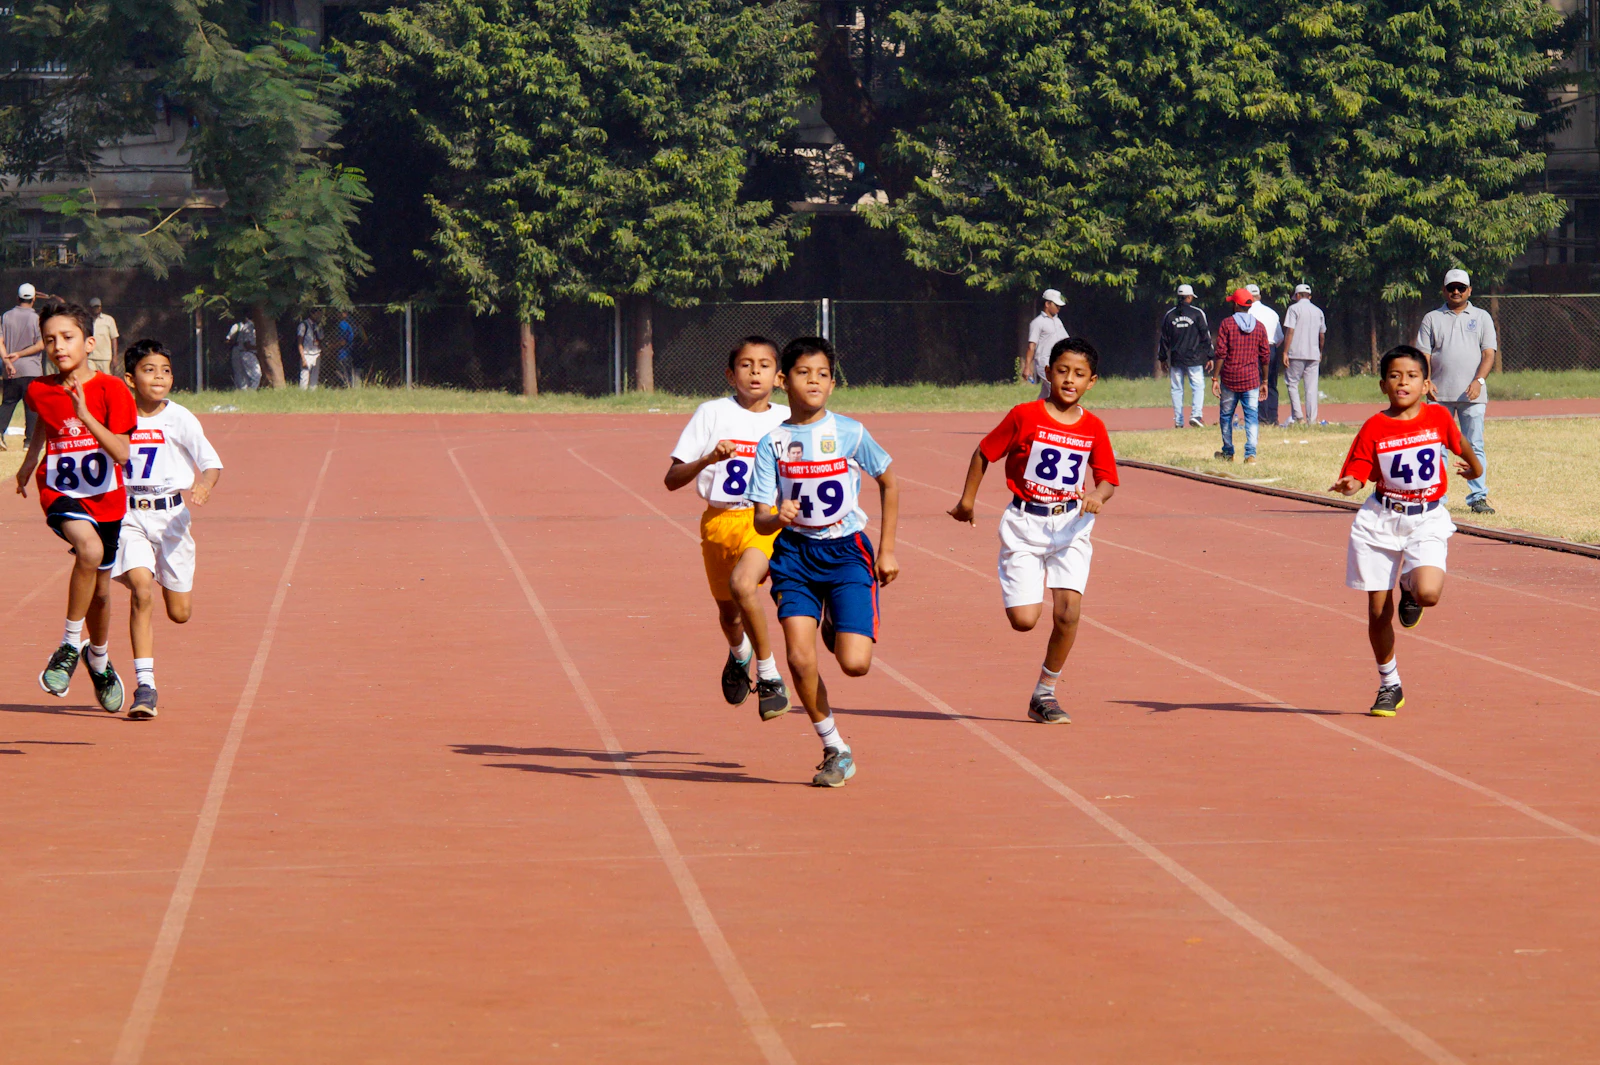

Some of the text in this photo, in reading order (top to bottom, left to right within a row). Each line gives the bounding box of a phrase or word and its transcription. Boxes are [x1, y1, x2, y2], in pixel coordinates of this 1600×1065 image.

[73, 438, 95, 448] SCHOOL
[1038, 430, 1046, 439] ST.
[1047, 432, 1066, 444] MARY'S
[1066, 436, 1085, 448] SCHOOL
[1379, 441, 1387, 450] ST.
[1387, 437, 1408, 448] MARY'S
[55, 452, 107, 491] 80
[787, 465, 809, 475] MARY'S
[810, 463, 833, 474] SCHOOL
[1035, 448, 1083, 485] 83
[1390, 448, 1435, 484] 48
[790, 480, 844, 519] 49
